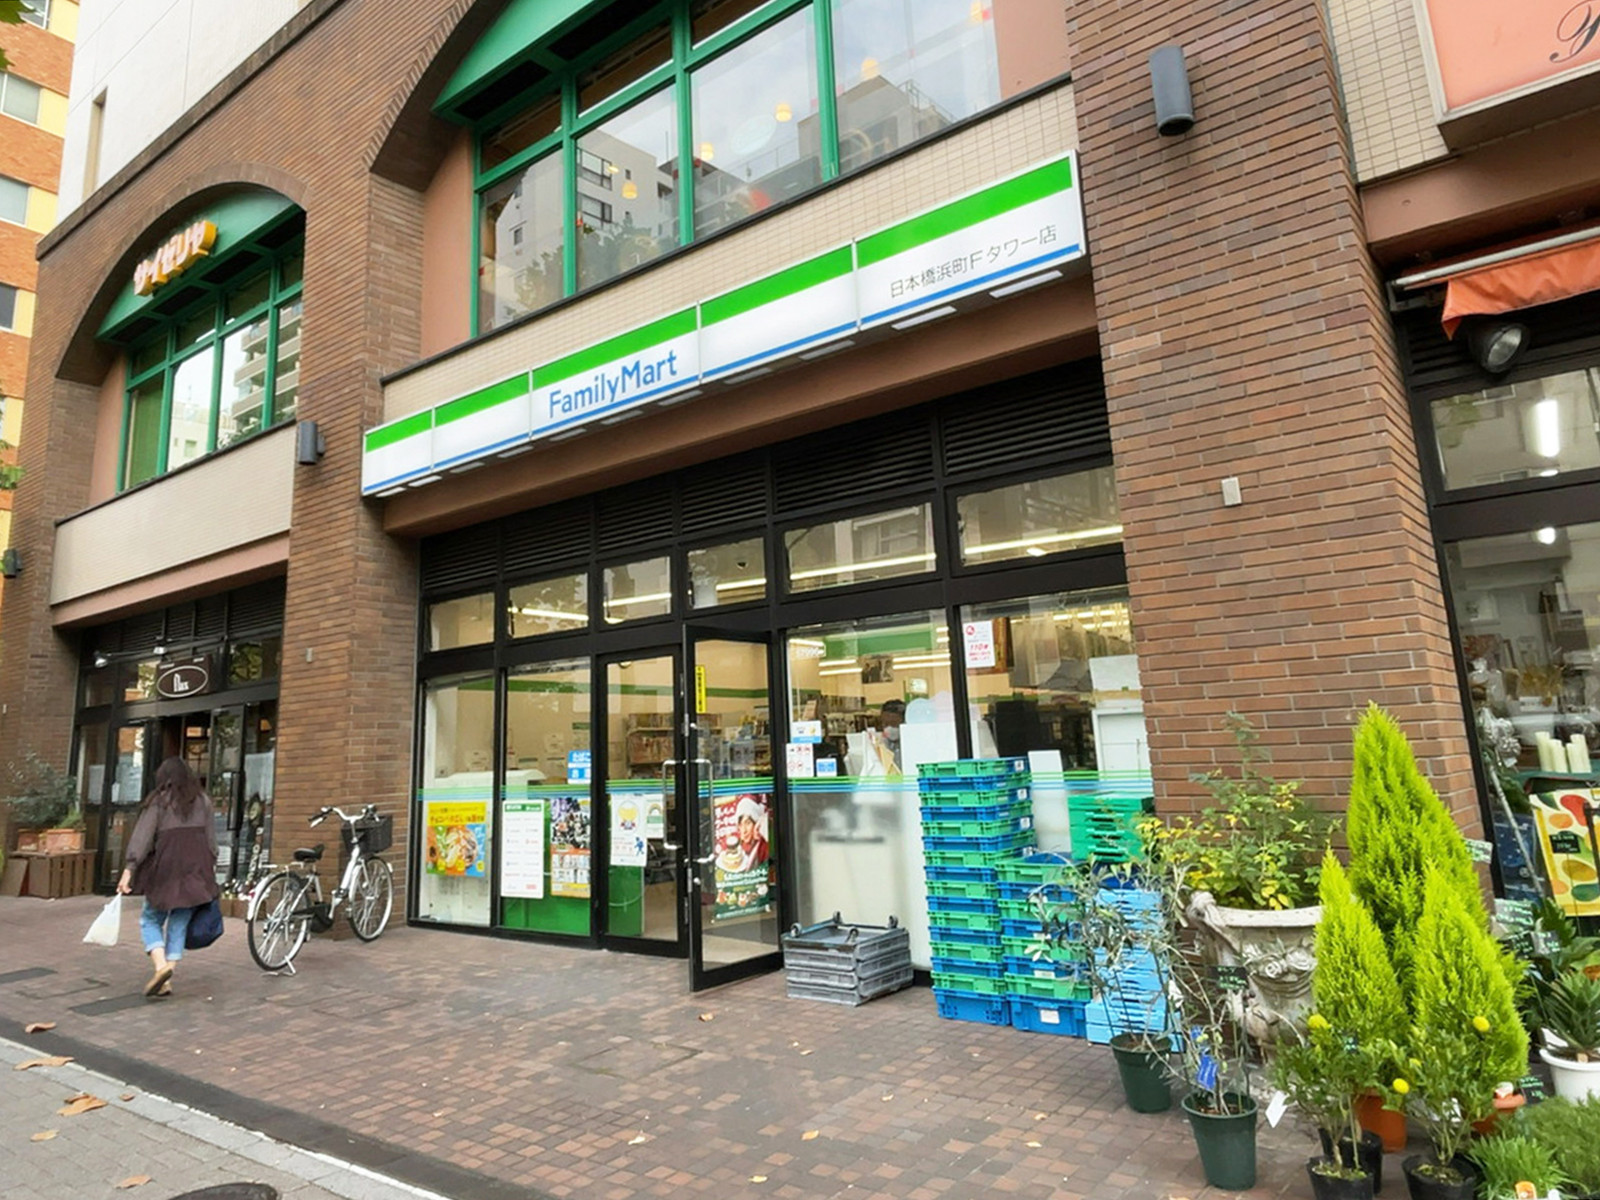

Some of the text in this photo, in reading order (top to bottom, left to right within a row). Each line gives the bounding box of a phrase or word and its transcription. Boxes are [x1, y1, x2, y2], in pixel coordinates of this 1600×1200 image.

[890, 225, 1057, 298] 日本橋浜町Fタワー店
[549, 350, 677, 418] FamilyMart
